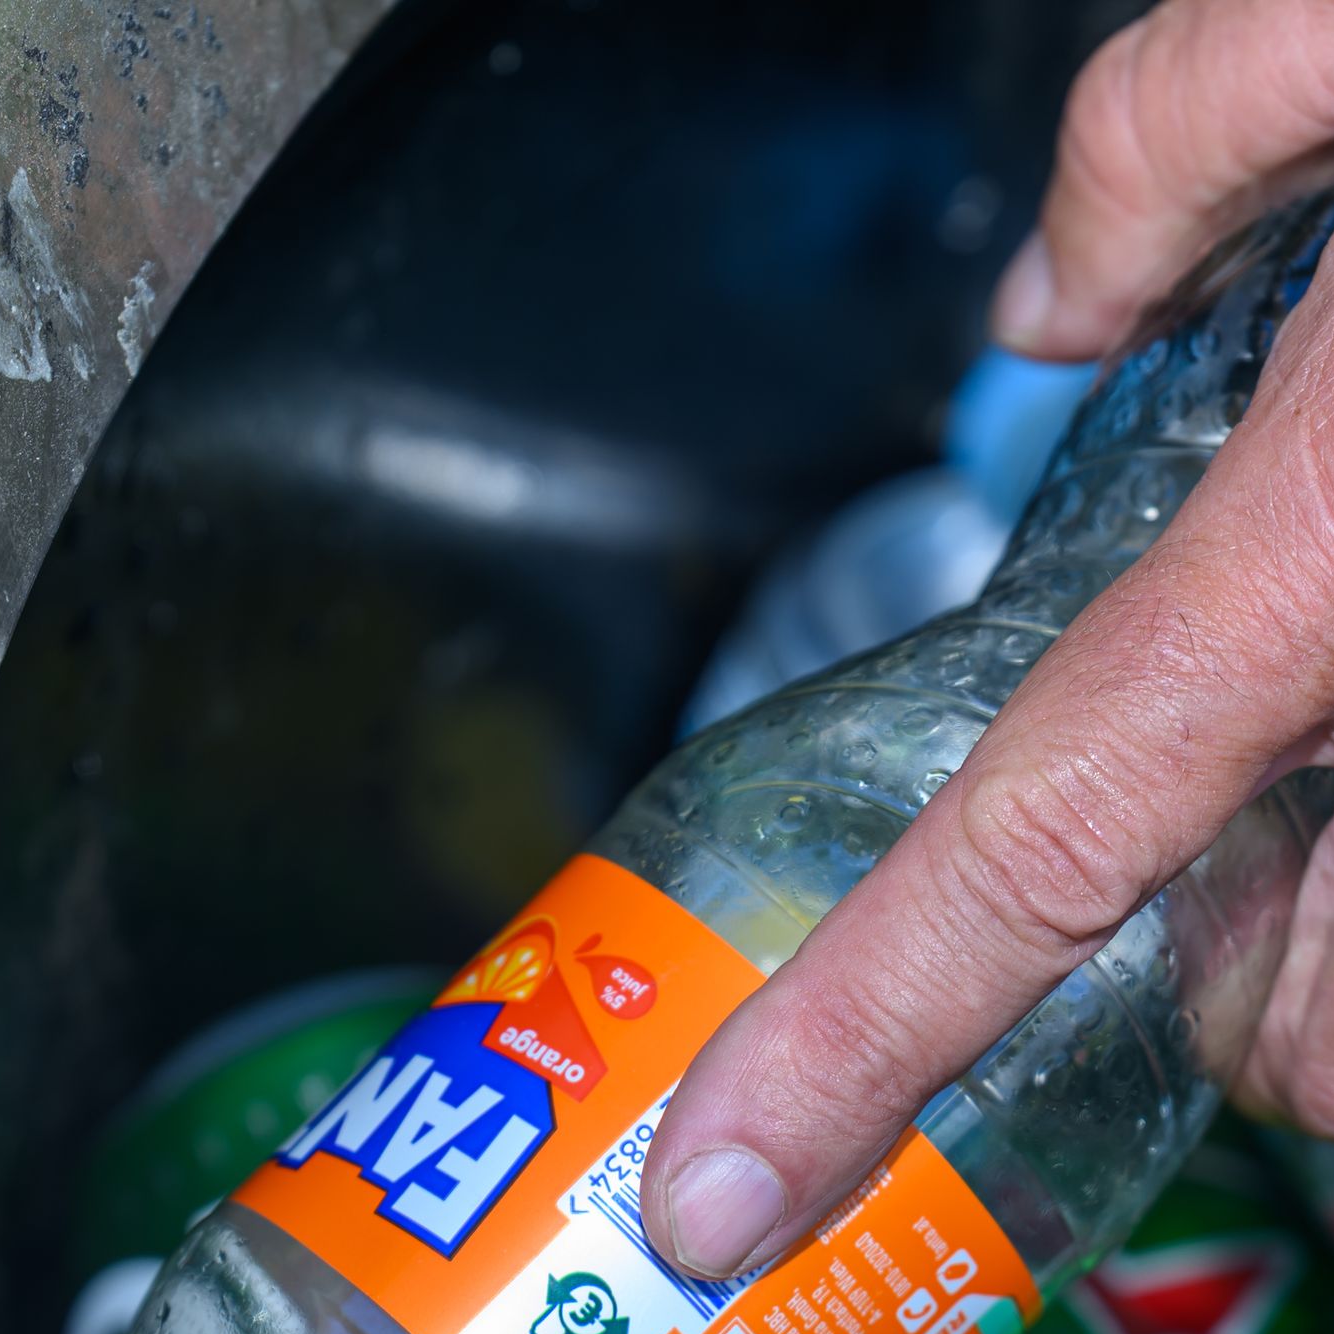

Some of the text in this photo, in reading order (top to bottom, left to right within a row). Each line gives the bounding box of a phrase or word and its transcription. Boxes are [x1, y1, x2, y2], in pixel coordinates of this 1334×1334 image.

[600, 984, 627, 1011] 5%
[610, 966, 650, 1000] juice
[499, 1026, 586, 1084] orange
[278, 1053, 541, 1245] FAN
[911, 1214, 951, 1260] fanta.at
[824, 1255, 858, 1293] Wien.
[786, 1286, 820, 1327] GmbH,
